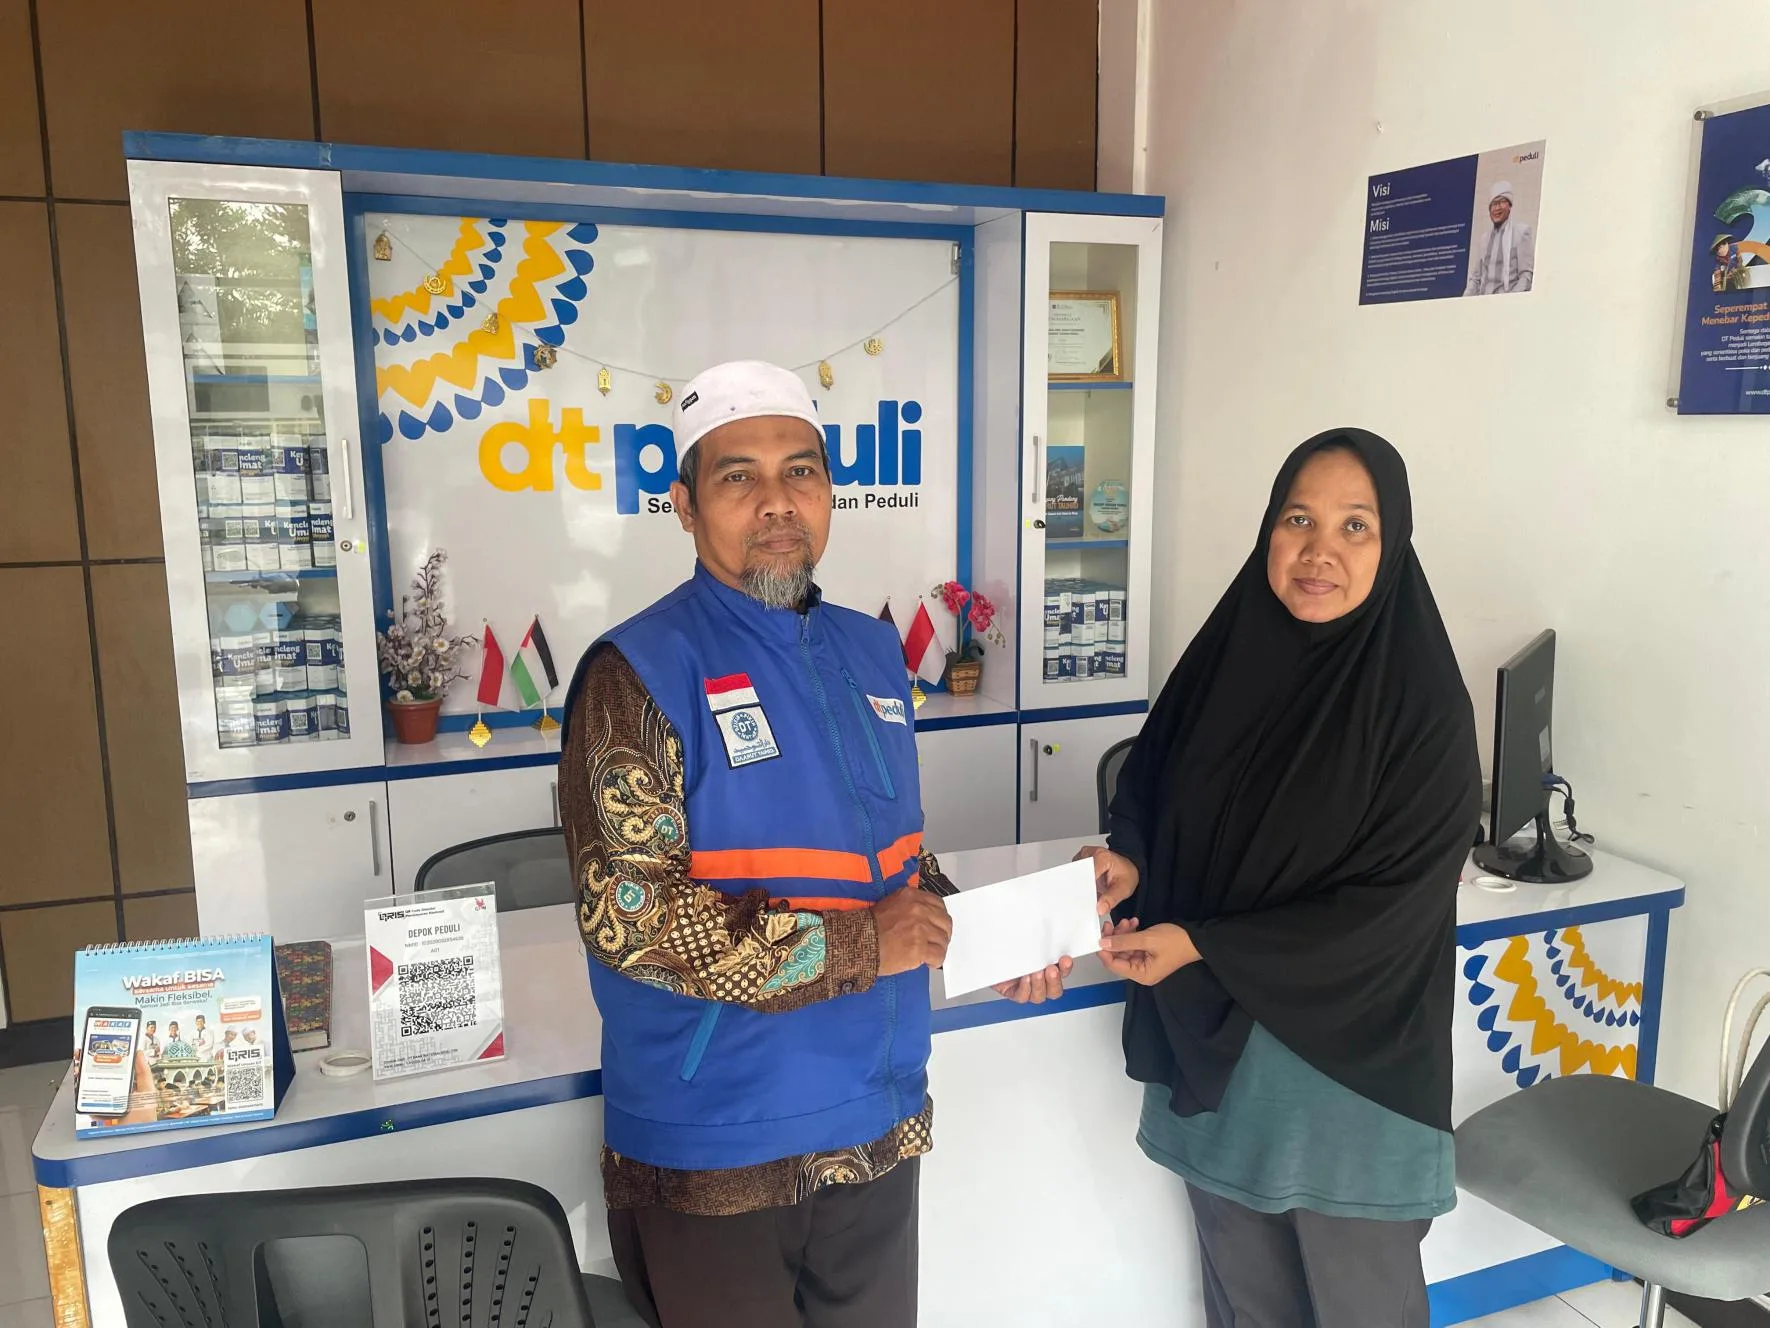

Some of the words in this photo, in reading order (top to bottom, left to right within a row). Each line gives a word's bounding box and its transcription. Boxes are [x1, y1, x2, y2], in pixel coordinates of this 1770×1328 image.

[1372, 183, 1391, 198] Visi
[1370, 217, 1390, 233] Misi
[1714, 302, 1768, 314] Seperempat
[1701, 315, 1739, 327] Menebar
[478, 398, 602, 493] dt
[613, 400, 922, 515] puli
[865, 493, 920, 509] Peduli
[738, 719, 752, 733] DT
[378, 911, 405, 921] QRIS
[408, 927, 433, 938] DEPOK
[434, 923, 461, 935] PEDULI
[122, 972, 180, 990] Wakaf
[184, 967, 225, 983] BISA
[135, 996, 165, 1005] Makin
[228, 1048, 261, 1061] QRIS
